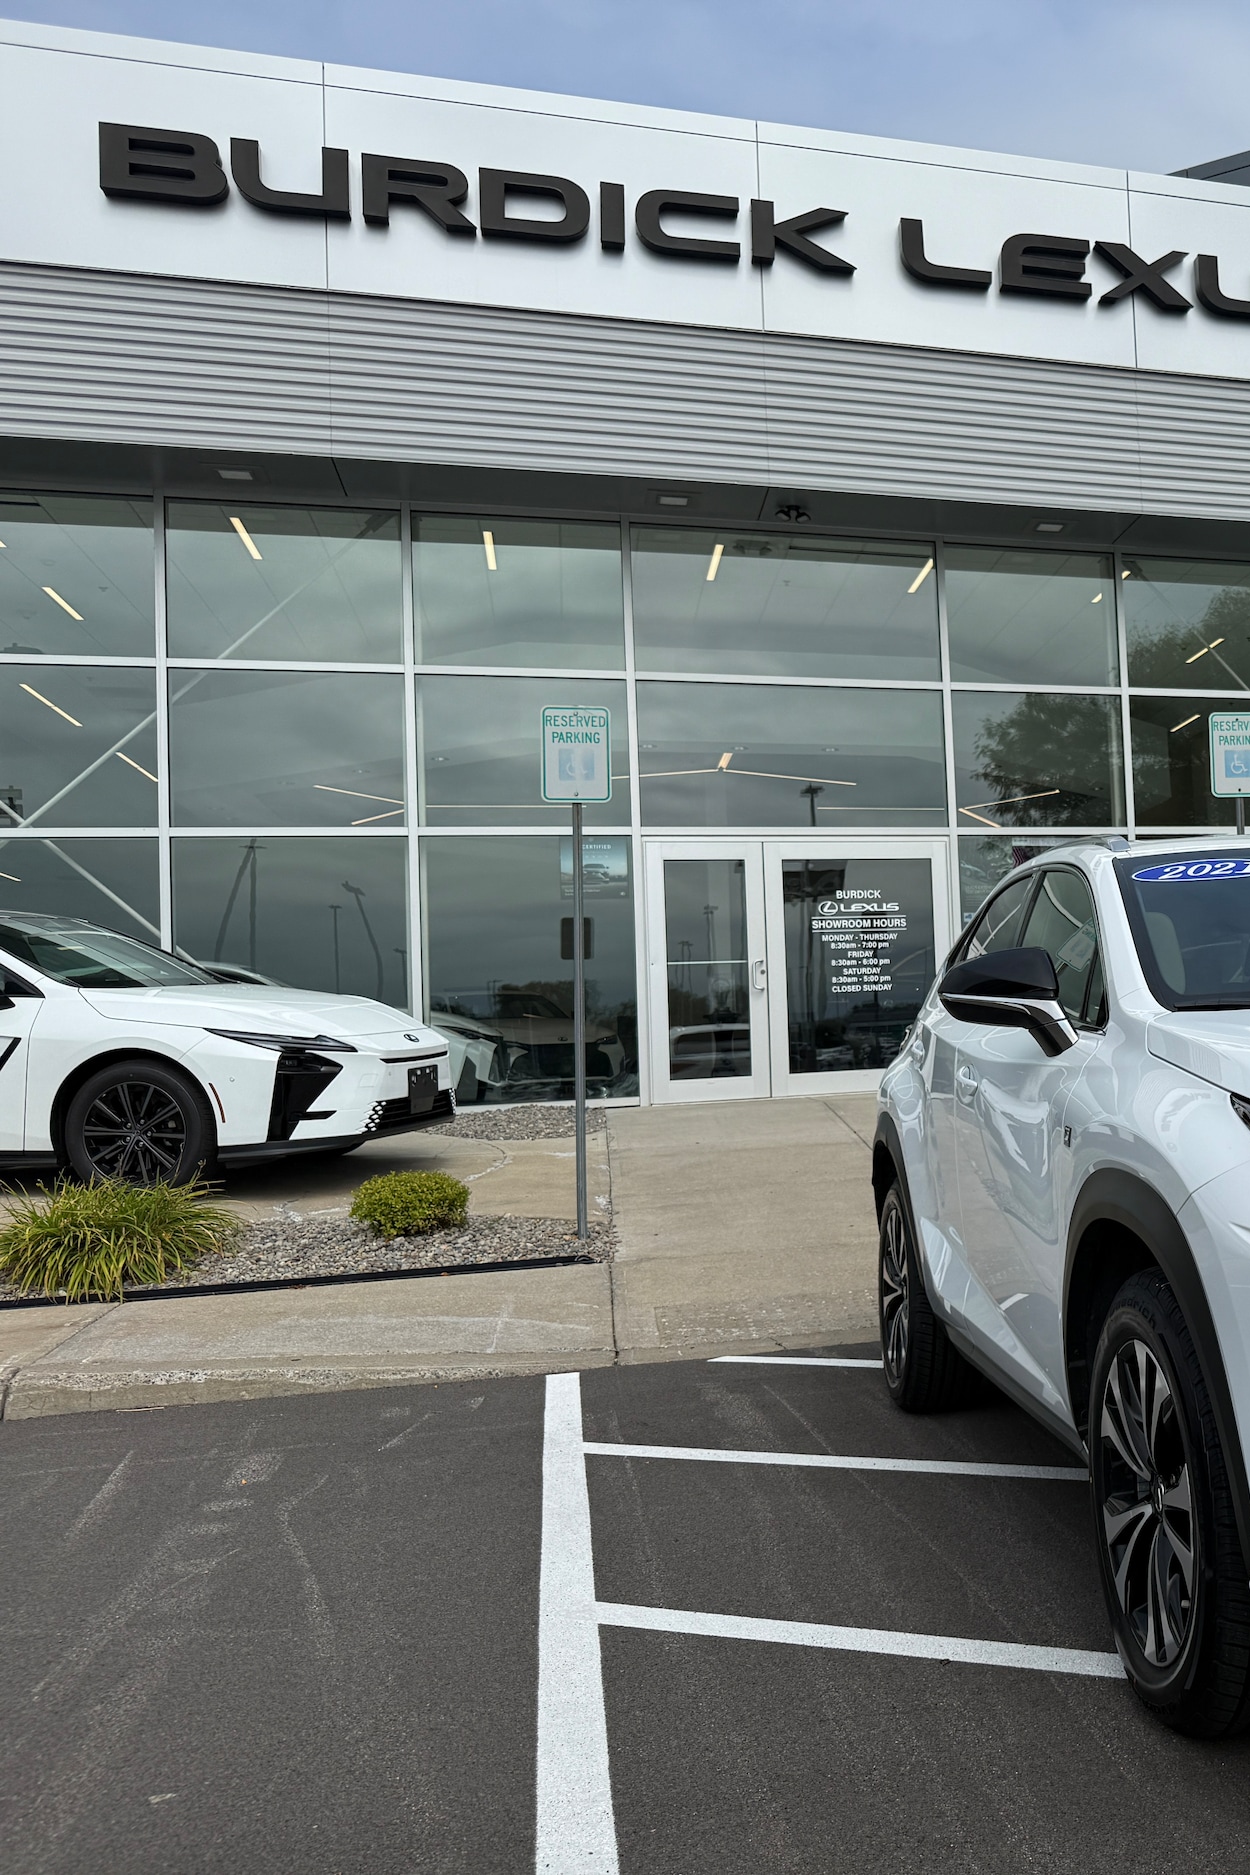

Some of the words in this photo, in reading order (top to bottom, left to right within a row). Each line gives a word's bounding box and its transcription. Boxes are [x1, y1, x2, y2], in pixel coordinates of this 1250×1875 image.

[98, 121, 858, 276] BURDICK
[545, 715, 606, 727] RESERVED
[552, 731, 600, 744] PARKING
[836, 889, 882, 900] BURDICK
[840, 902, 900, 912] LEXUS
[811, 919, 871, 929] SHOWROOM
[873, 918, 907, 928] HOURS
[821, 934, 854, 942] MONDAY
[859, 933, 898, 941] THURSDAY
[878, 941, 890, 949] pm
[847, 950, 874, 958] FRIDAY
[879, 958, 891, 966] pm
[842, 967, 881, 975] SATURDAY
[831, 976, 858, 984] 8:30am
[880, 975, 892, 983] pm
[831, 985, 861, 993] CLOSED
[862, 983, 893, 992] SUNDAY
